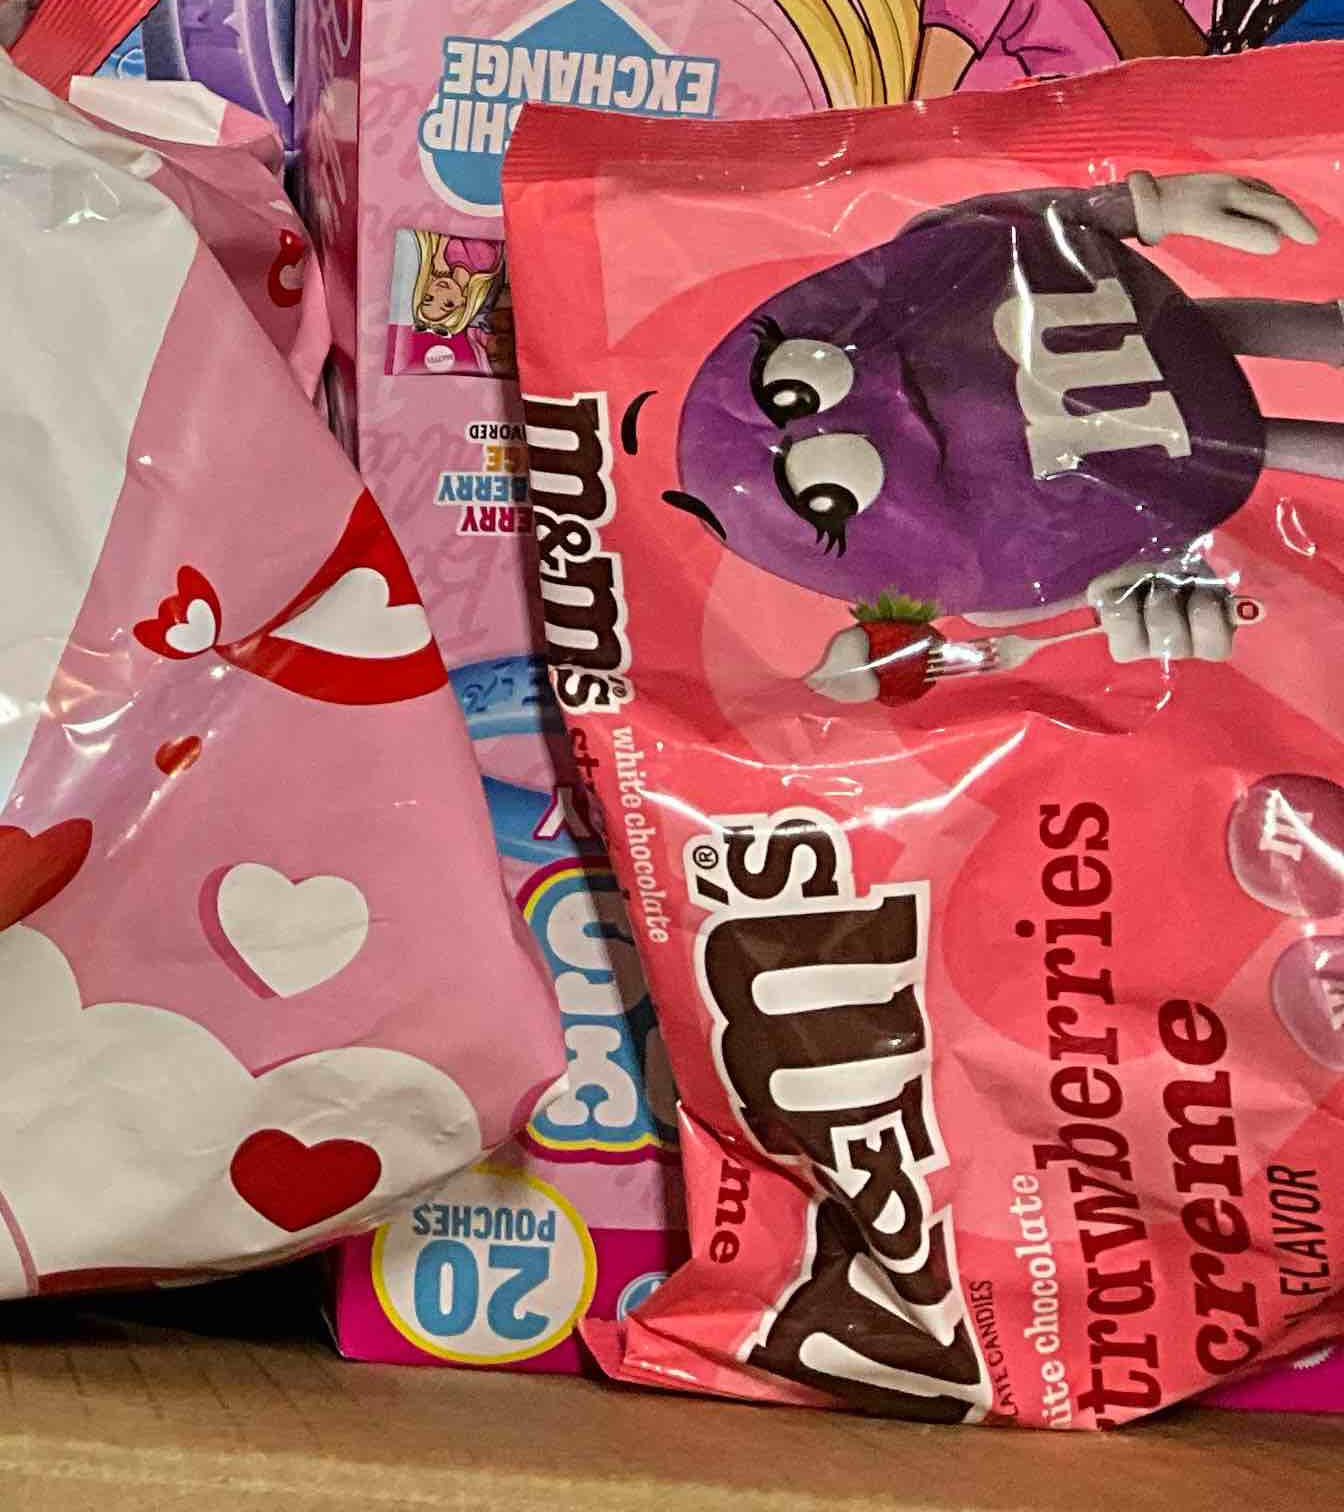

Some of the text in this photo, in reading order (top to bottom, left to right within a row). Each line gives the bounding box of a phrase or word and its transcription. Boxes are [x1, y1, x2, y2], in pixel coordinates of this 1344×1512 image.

[422, 99, 515, 155] HIP
[443, 41, 716, 115] EXCHANGE
[613, 726, 673, 945] white chocolate
[1015, 801, 1163, 1432] trawberries
[412, 1204, 557, 1241] POUCHES
[1157, 998, 1264, 1375] creme
[1266, 1164, 1331, 1297] FLAVOR
[413, 1238, 552, 1341] 20
[969, 1279, 1004, 1366] CANDIES
[1009, 1174, 1062, 1355] chocolate
